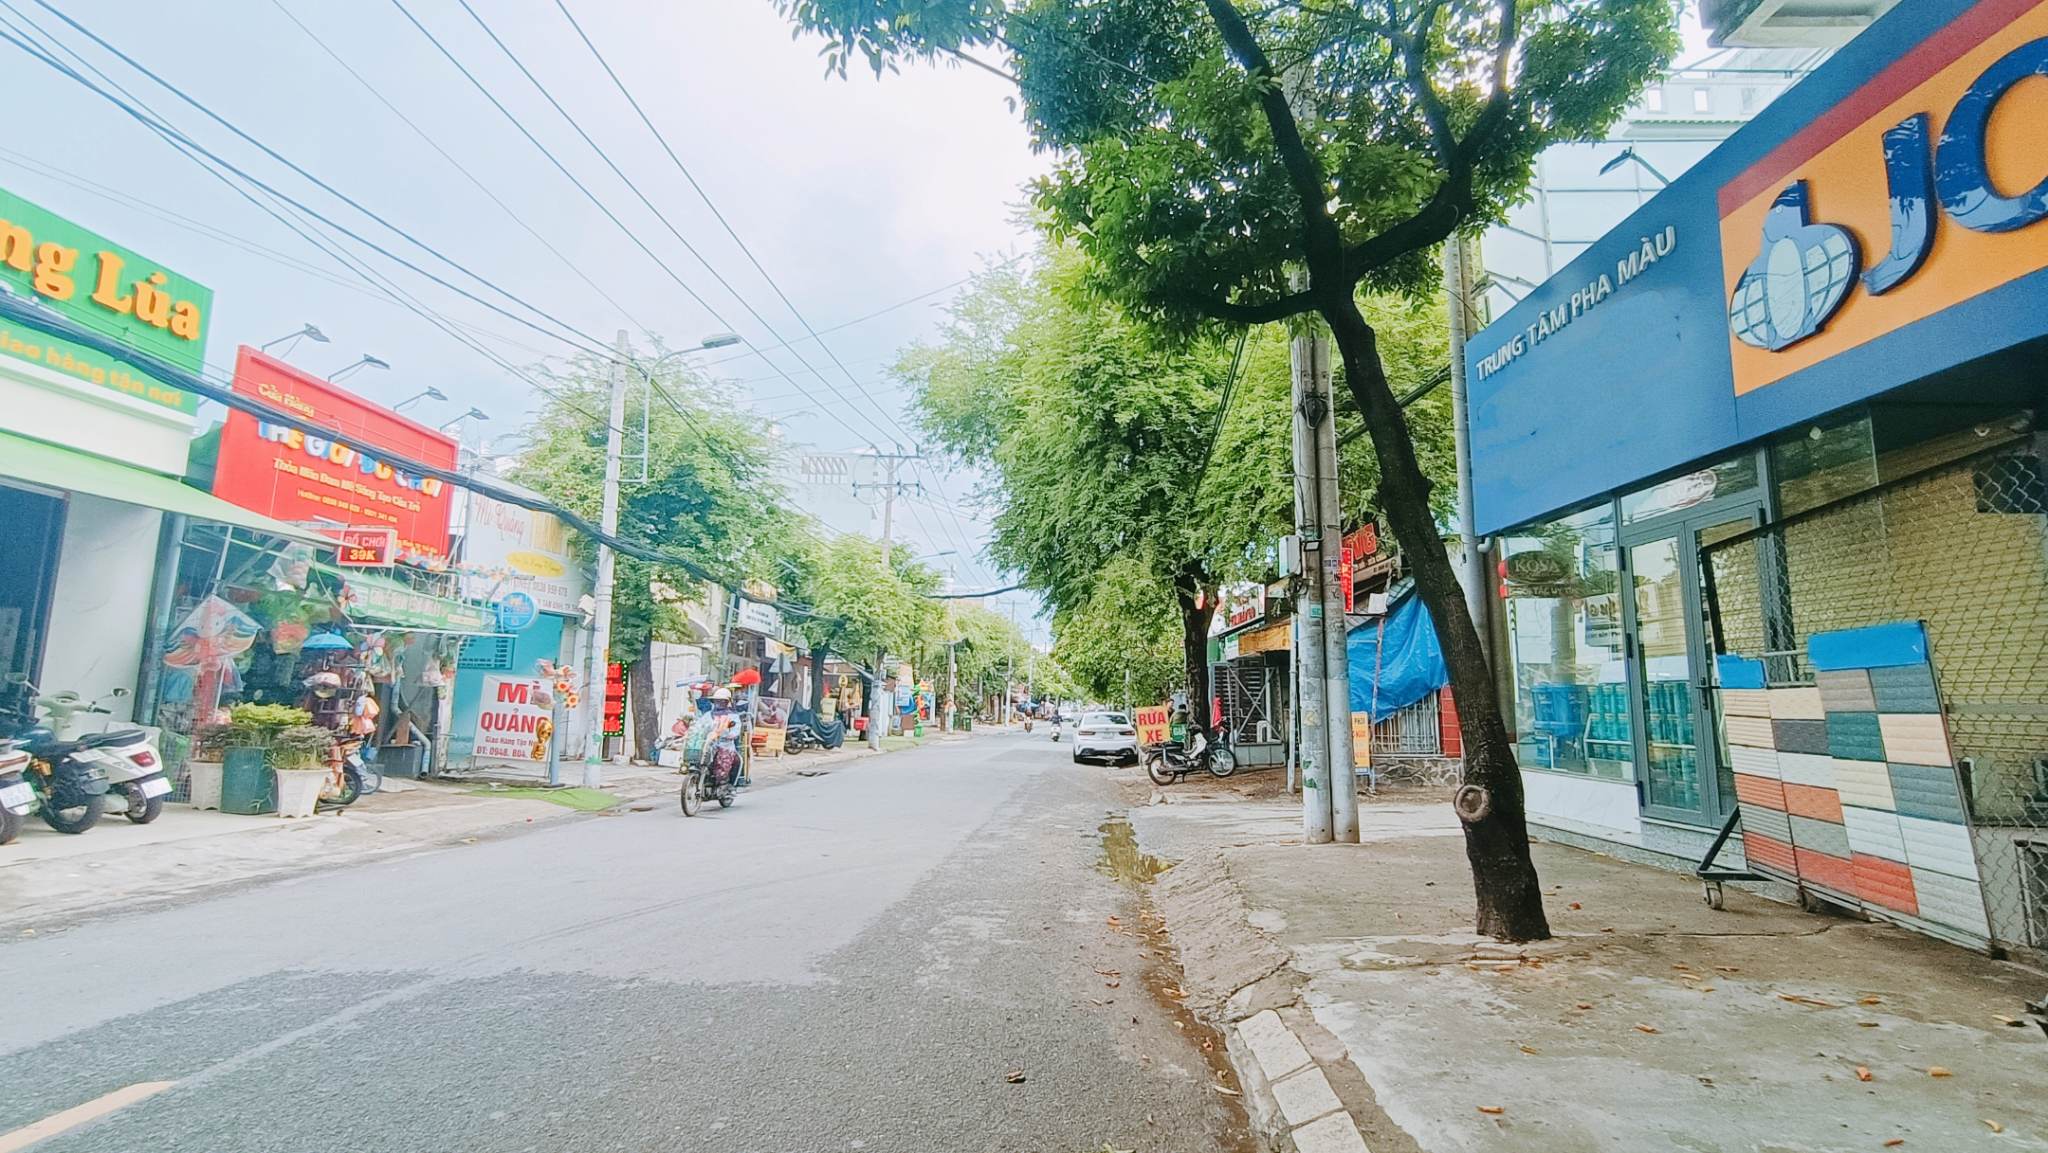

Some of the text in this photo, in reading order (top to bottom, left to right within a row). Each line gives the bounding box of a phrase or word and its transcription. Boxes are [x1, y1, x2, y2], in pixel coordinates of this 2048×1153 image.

[1476, 225, 1678, 381] TRUNG TÂM PHA MÀU
[1146, 729, 1163, 743] XE
